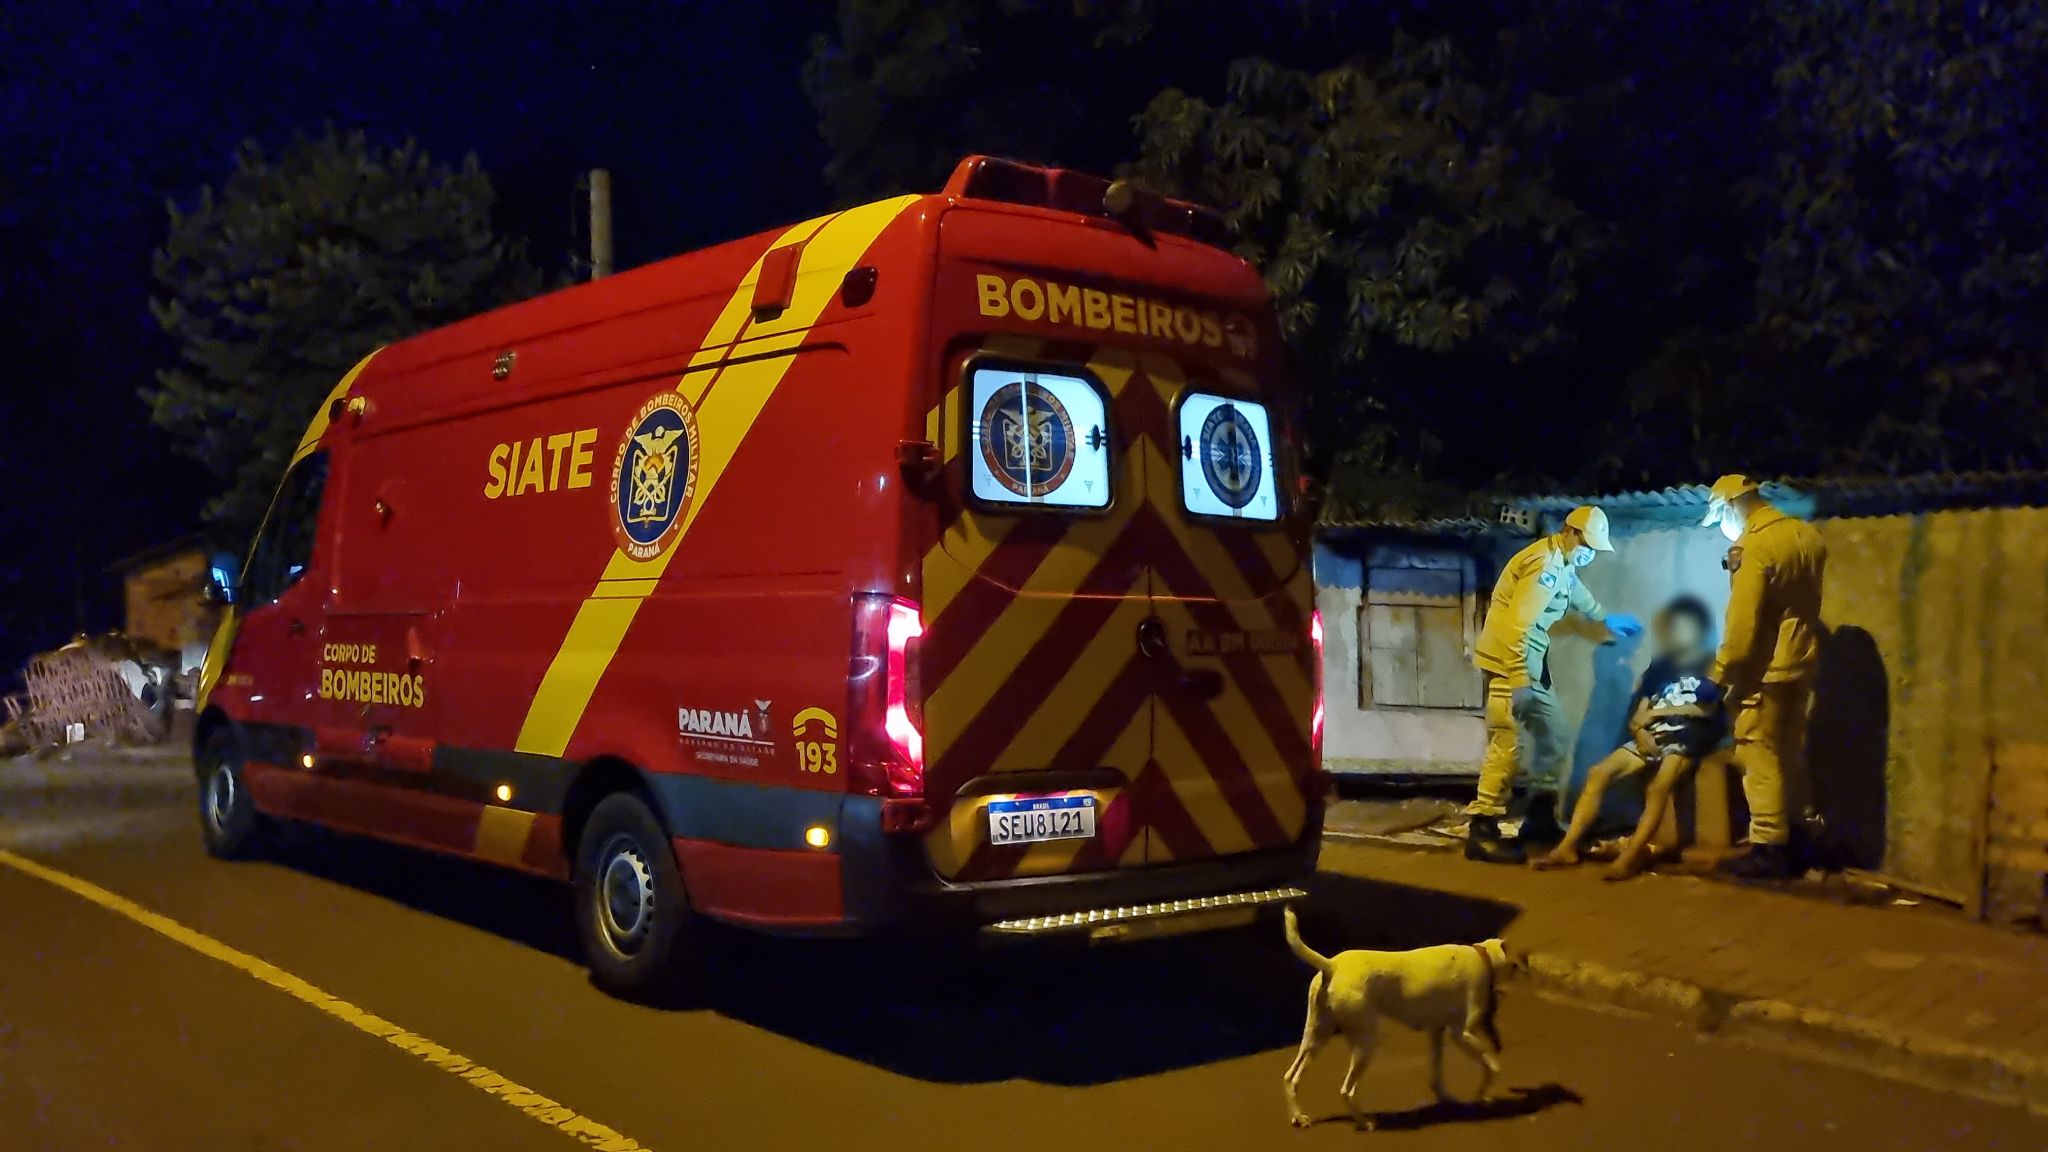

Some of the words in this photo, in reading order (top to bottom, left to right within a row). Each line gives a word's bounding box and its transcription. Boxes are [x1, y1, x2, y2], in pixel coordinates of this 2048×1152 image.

[976, 273, 1223, 347] BOMBEIROS
[484, 427, 598, 500] SIATE
[610, 443, 626, 504] CORPO
[625, 419, 639, 439] DE
[640, 393, 694, 424] BOMBEIROS
[684, 423, 700, 498] MILITAR
[628, 540, 661, 559] PARANÁ
[323, 643, 359, 664] CORPO
[361, 644, 376, 664] DE
[320, 669, 424, 708] BOMBEIROS
[678, 708, 752, 738] PARANÁ
[796, 741, 837, 775] 193
[998, 810, 1085, 841] SEU8121
